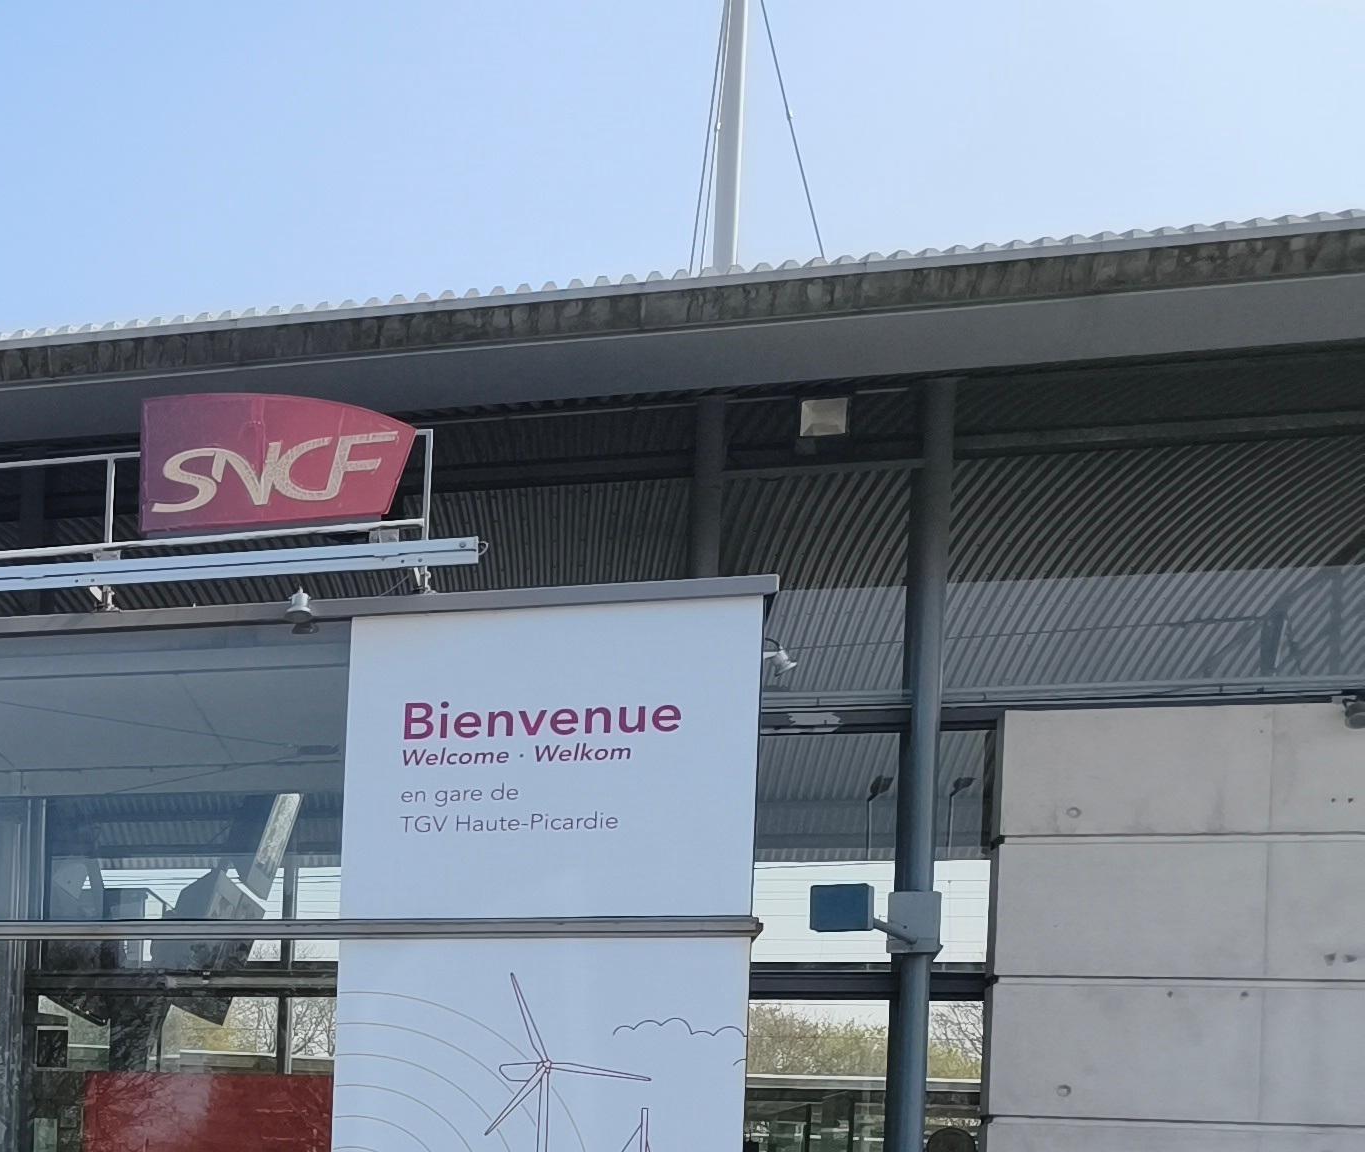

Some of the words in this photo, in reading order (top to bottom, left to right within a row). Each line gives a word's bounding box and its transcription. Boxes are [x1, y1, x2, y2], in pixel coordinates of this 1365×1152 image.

[151, 430, 399, 513] SNCF
[403, 701, 683, 740] Bienvenue
[401, 747, 510, 767] Welcome
[534, 742, 632, 763] Welkom
[400, 788, 427, 803] en
[434, 786, 483, 807] gare
[490, 782, 520, 801] de
[400, 815, 449, 834] TGV
[456, 811, 620, 833] Haute-Picardie
